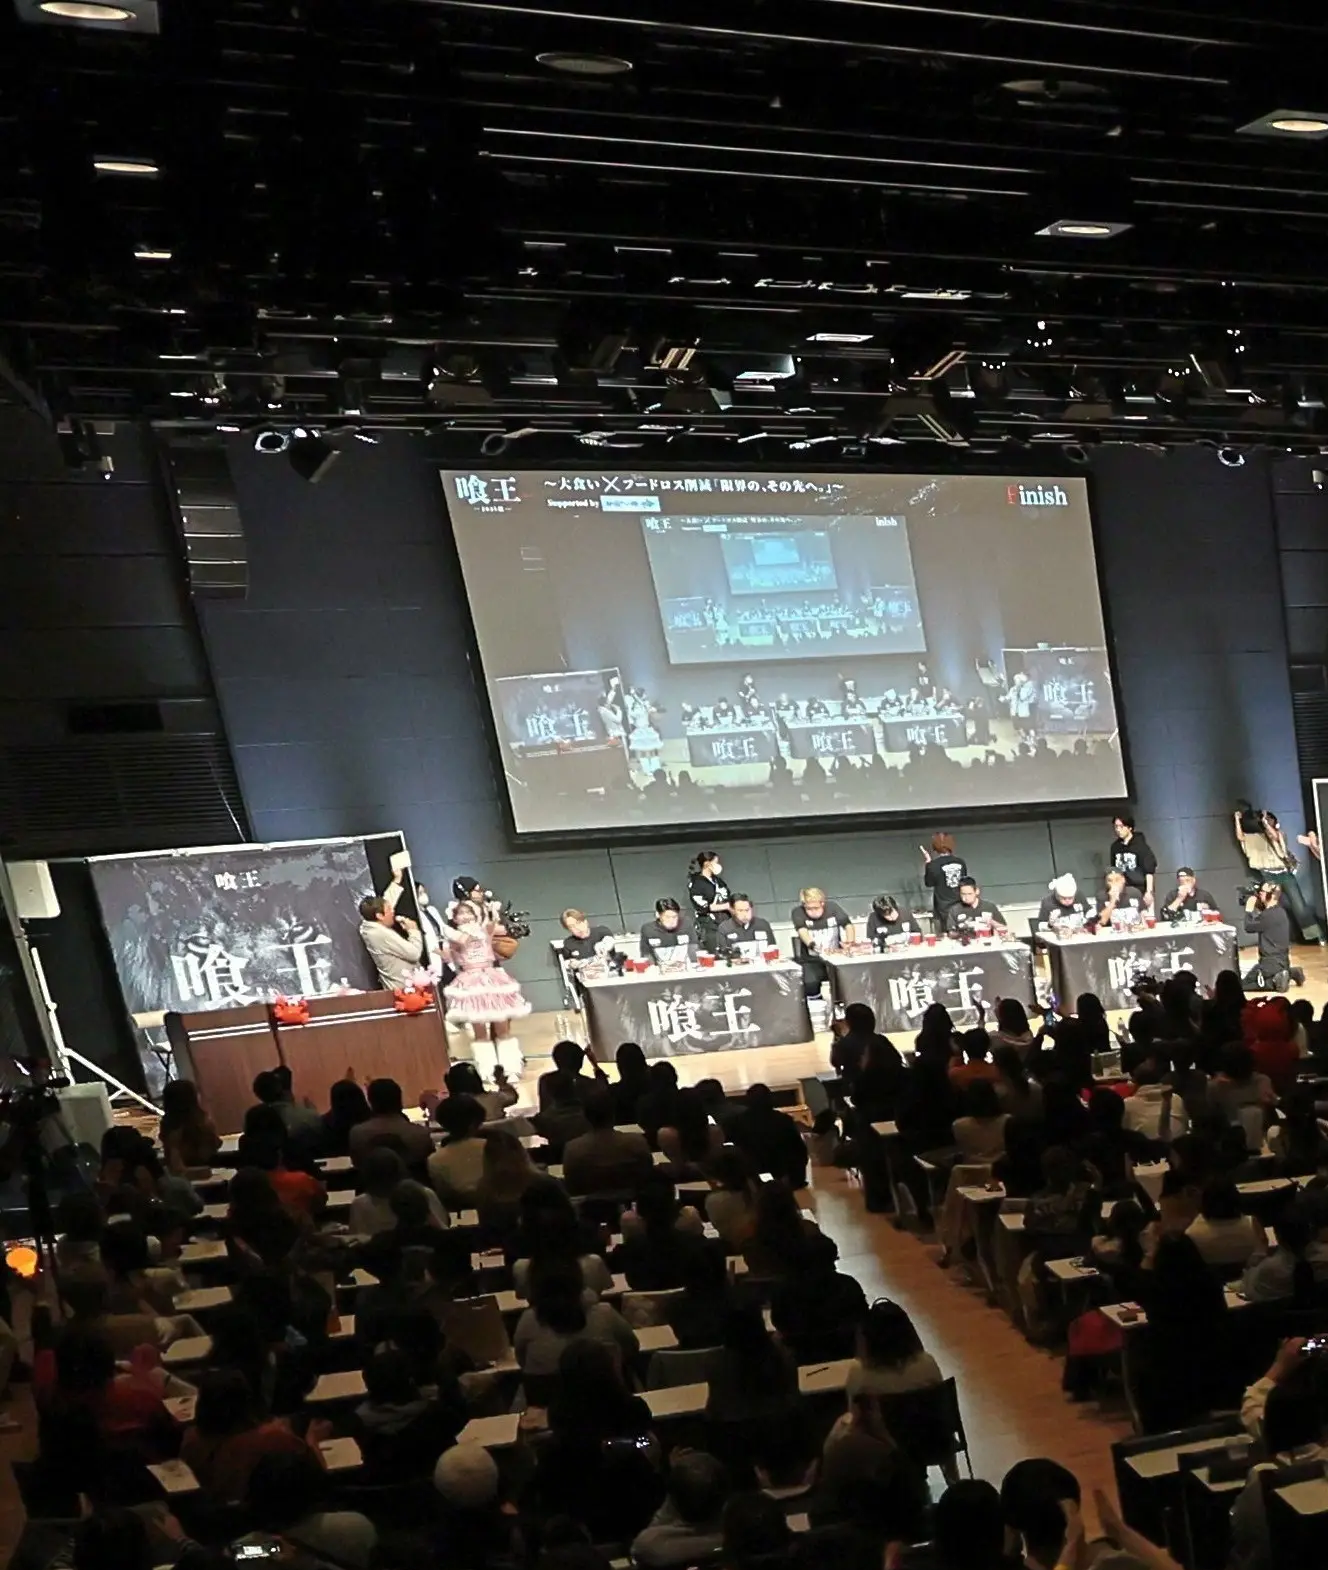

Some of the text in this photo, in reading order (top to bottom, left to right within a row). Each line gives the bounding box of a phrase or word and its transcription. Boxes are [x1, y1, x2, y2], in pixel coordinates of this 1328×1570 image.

[455, 474, 521, 504] 喰王
[214, 870, 262, 891] 喰王
[170, 934, 346, 1009] 喰王
[888, 966, 991, 1019] 喰王
[647, 987, 761, 1044] 喰王
